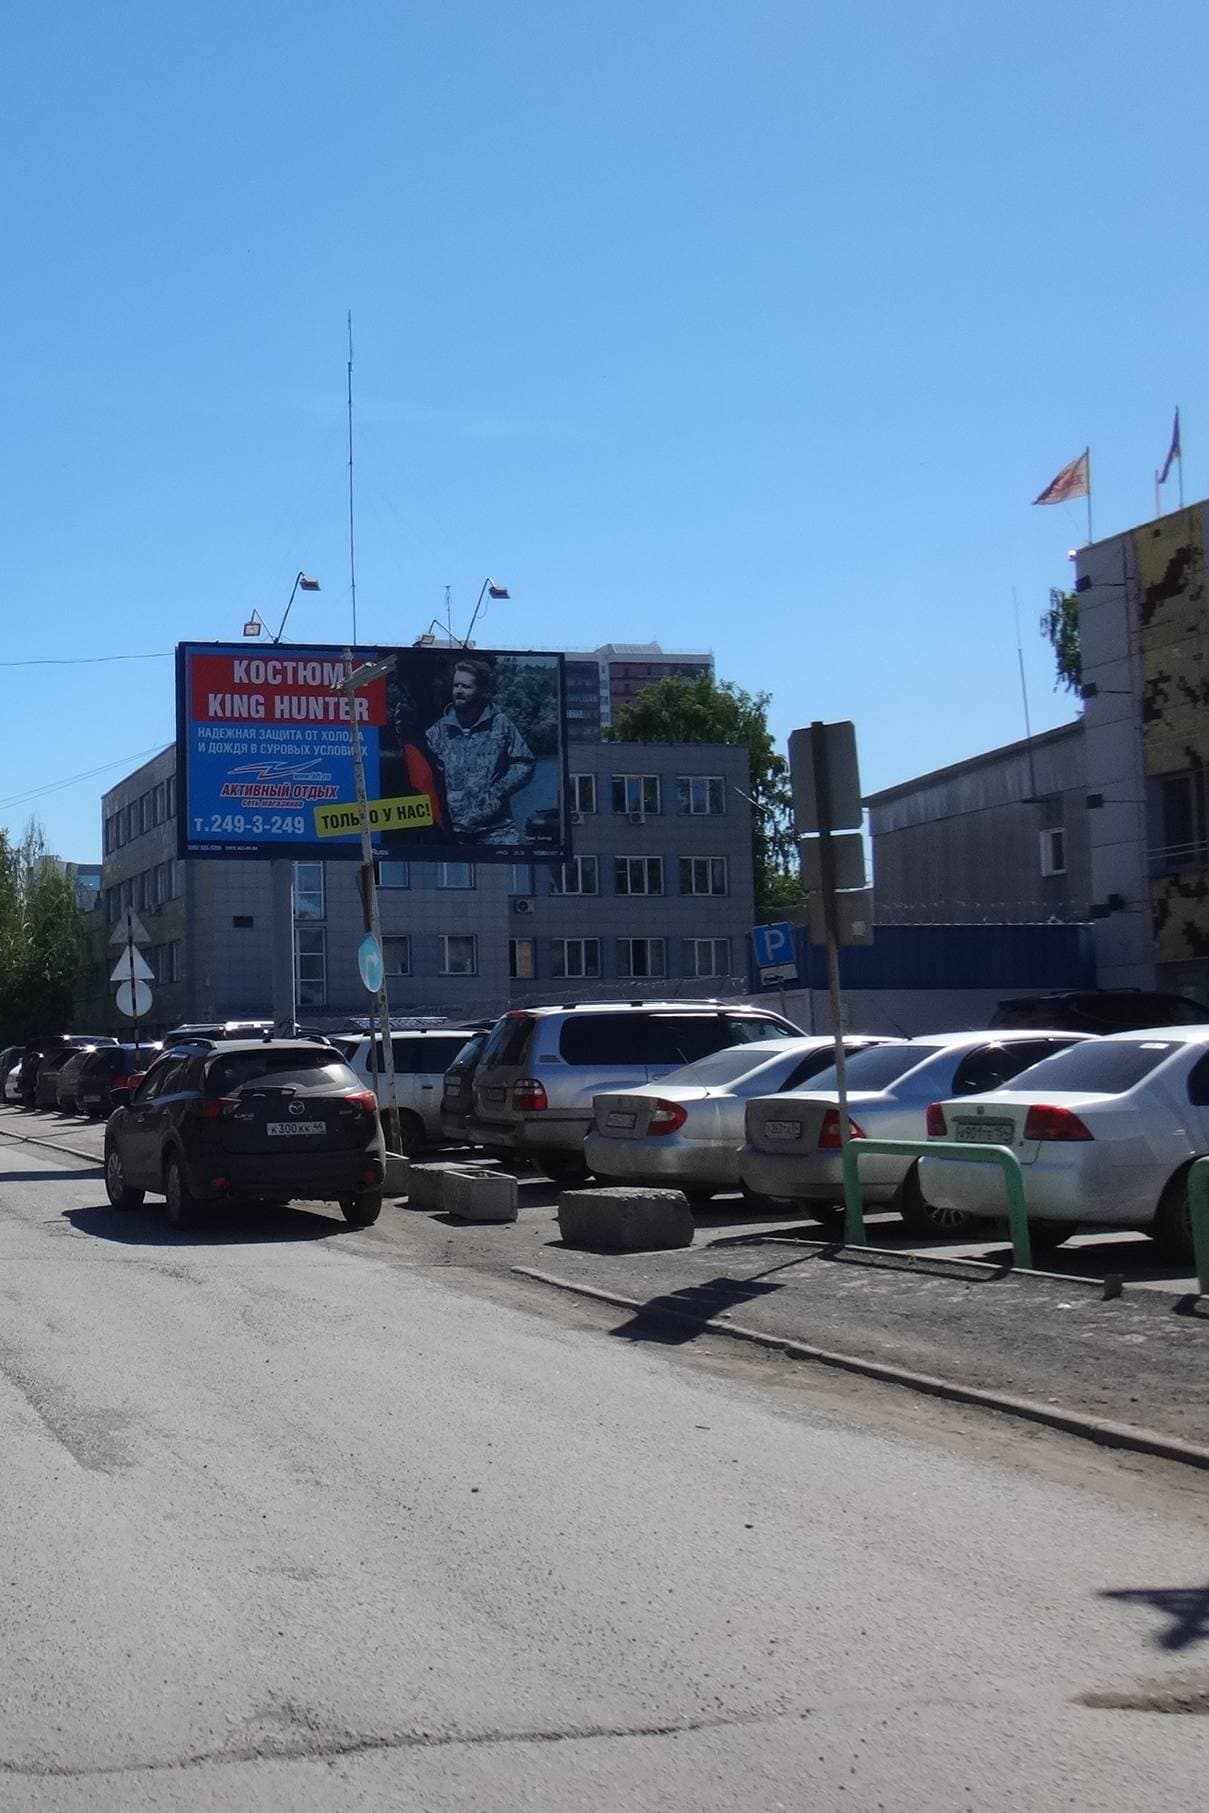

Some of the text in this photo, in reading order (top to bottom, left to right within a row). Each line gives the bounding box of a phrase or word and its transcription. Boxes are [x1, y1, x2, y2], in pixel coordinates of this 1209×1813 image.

[233, 660, 368, 687] КОСТЮМ
[208, 693, 369, 721] KING HUNTER
[198, 727, 256, 740] НАДЕЖНАЯ
[259, 728, 303, 742] ЗАЩИТА
[305, 730, 318, 741] ОТ
[198, 742, 368, 756] И ДОЖДЯ В СУРОВЫХ УСЛОВИХ
[221, 783, 340, 800] АКТИВНЫЙ ОТДЫХ
[321, 802, 431, 830] ТОЛЬО У НАС!
